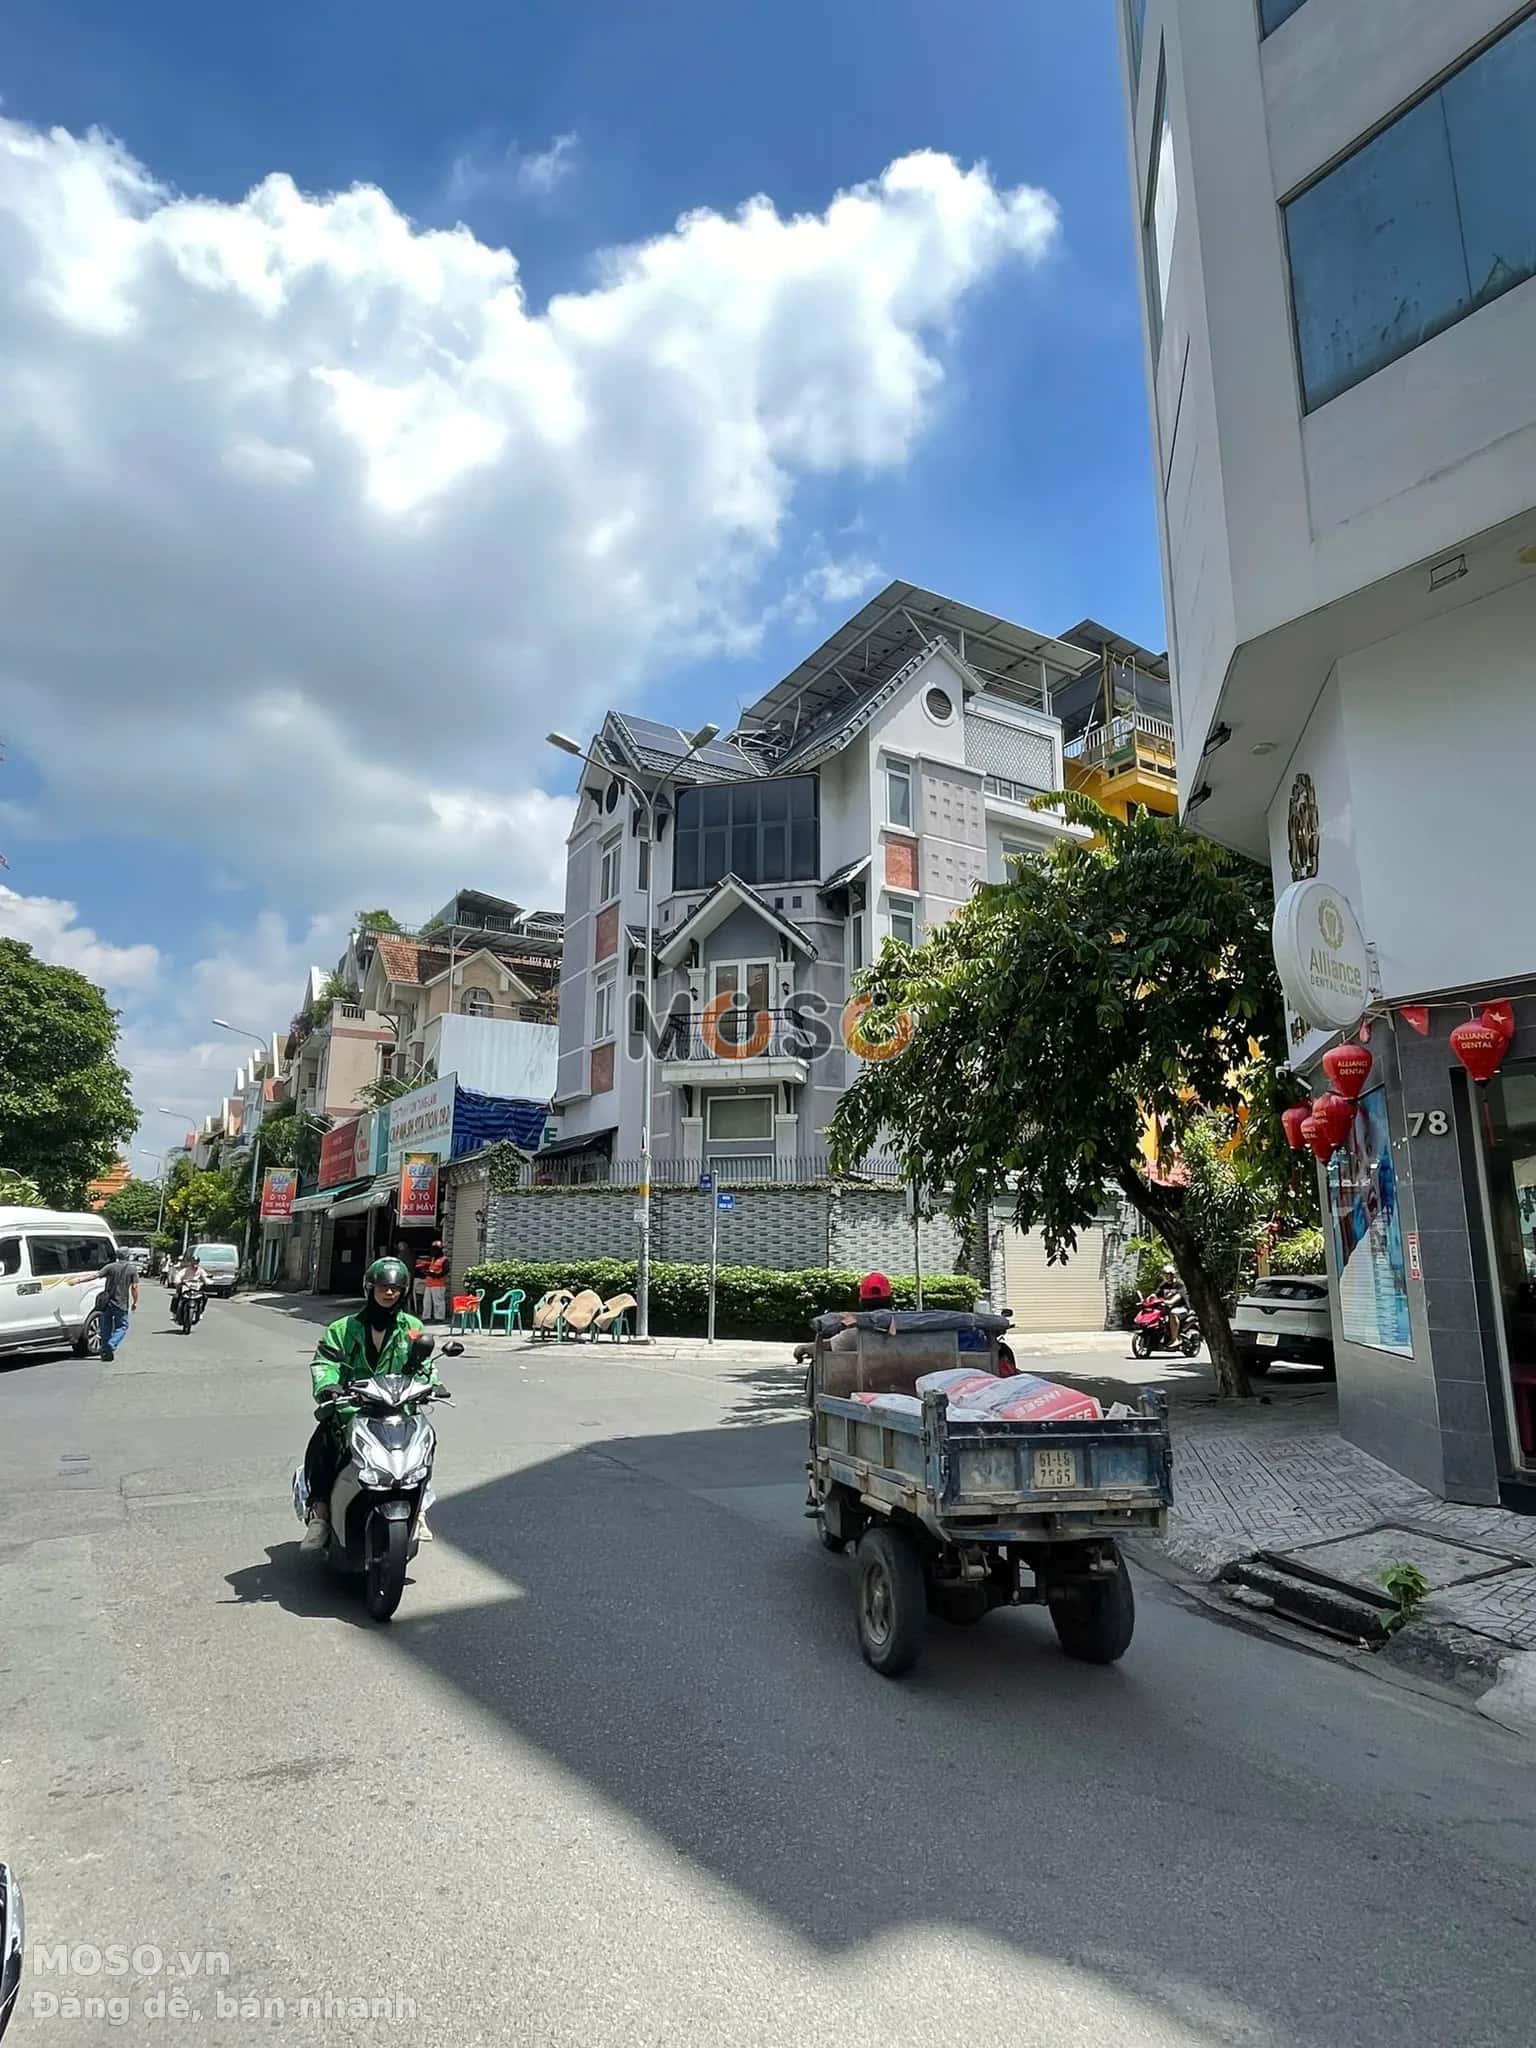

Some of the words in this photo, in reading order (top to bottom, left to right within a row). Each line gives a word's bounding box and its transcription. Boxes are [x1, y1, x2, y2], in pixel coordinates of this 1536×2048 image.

[1310, 947, 1361, 986] Alliance
[1461, 1041, 1492, 1049] DENTAL
[1407, 1110, 1448, 1137] 78
[403, 1203, 415, 1211] XE
[416, 1202, 434, 1211] MÁY
